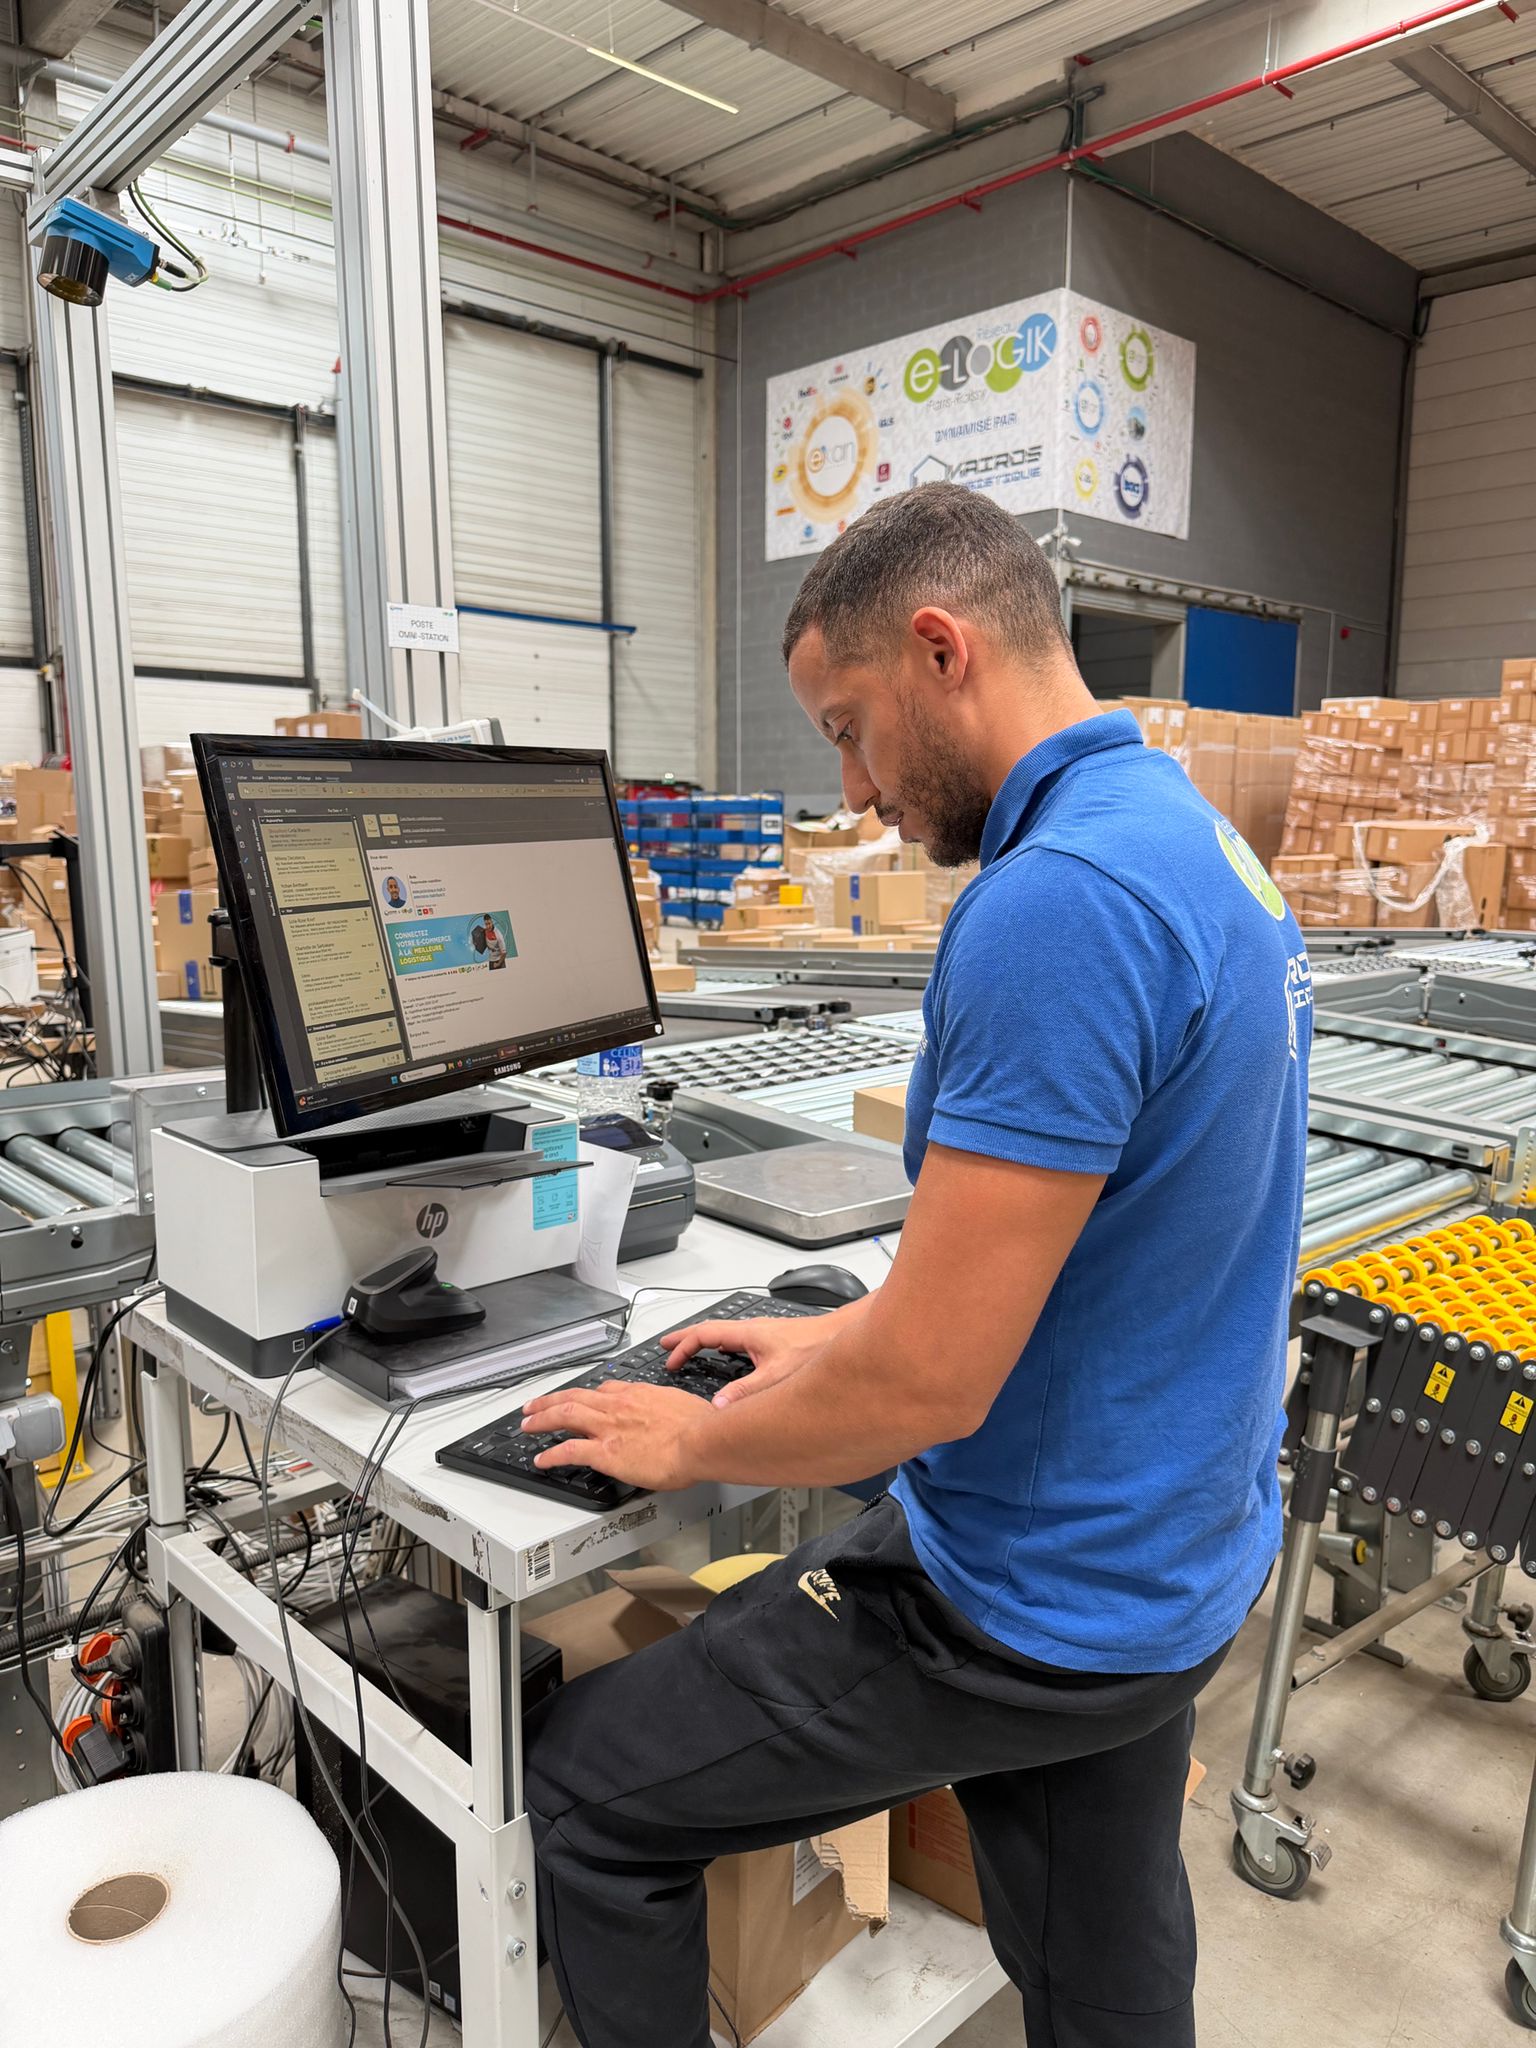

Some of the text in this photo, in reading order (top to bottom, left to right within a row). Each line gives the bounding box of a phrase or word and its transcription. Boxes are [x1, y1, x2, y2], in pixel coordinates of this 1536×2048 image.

[410, 619, 435, 630] POSTE
[493, 1061, 522, 1076] SAMSUNG
[418, 1203, 447, 1240] hp
